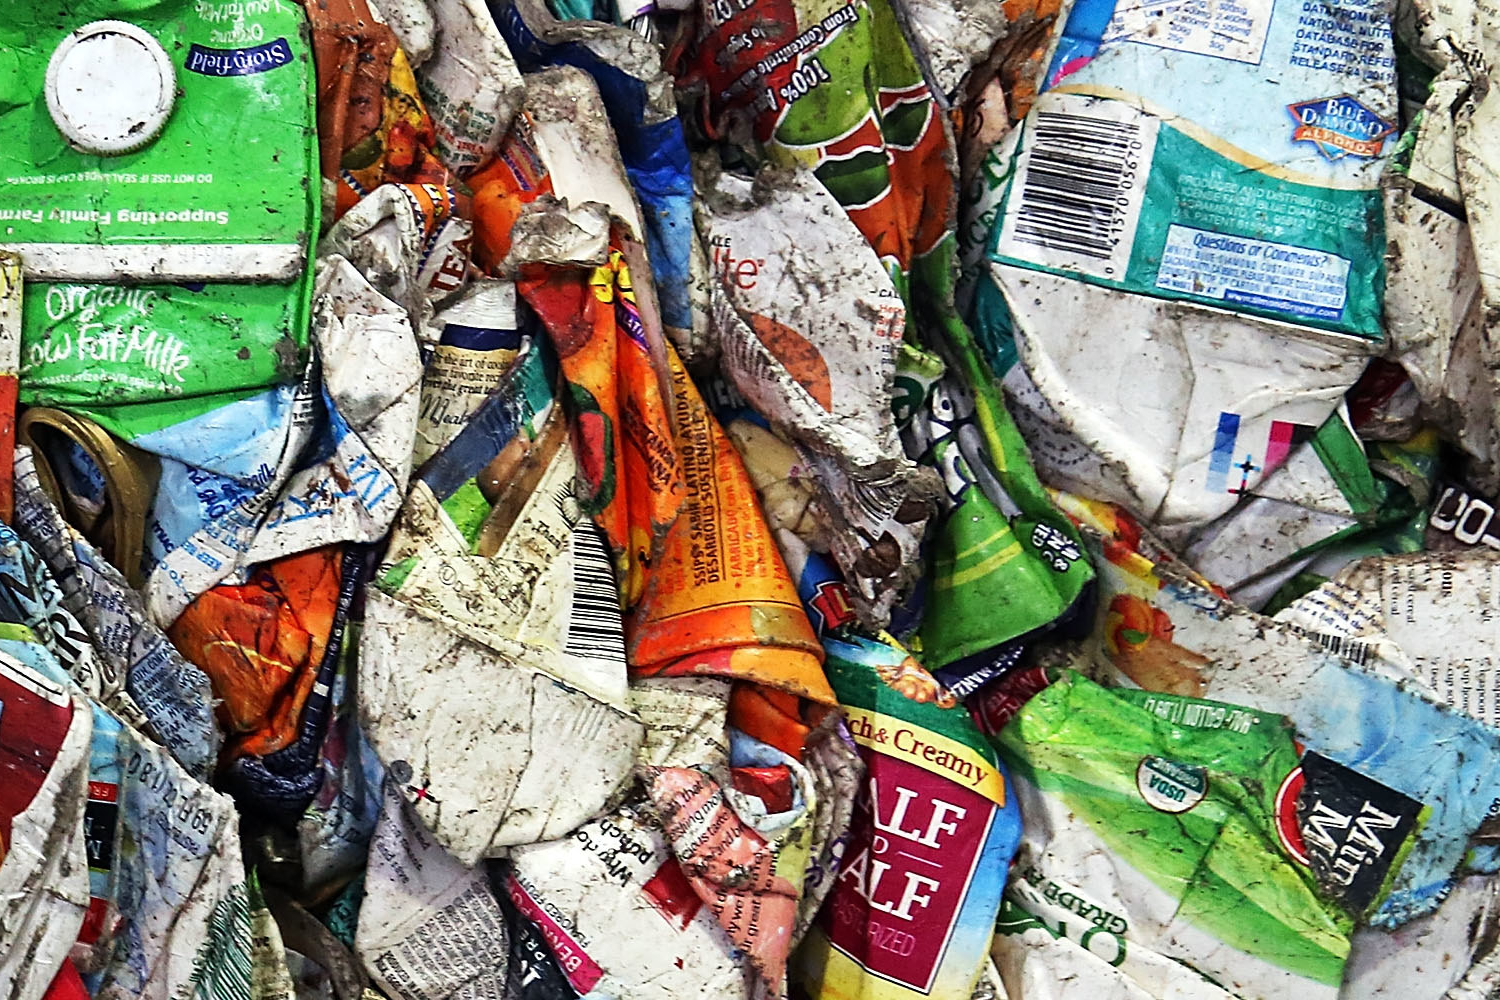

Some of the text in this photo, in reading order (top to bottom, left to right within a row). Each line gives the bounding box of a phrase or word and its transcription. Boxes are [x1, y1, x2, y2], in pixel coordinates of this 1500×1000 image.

[758, 5, 858, 73] From Concentrate
[1301, 108, 1384, 139] DIAMOND
[1325, 98, 1366, 124] BLUE
[138, 171, 149, 183] IF
[151, 171, 171, 183] USE
[172, 171, 195, 183] NOT
[1120, 140, 1143, 190] 05670
[116, 207, 228, 224] Supporting
[1193, 233, 1247, 254] Questions
[1249, 244, 1260, 256] or
[893, 727, 989, 786] Creamy
[1148, 772, 1187, 803] USDA
[1042, 881, 1129, 937] GRADE
